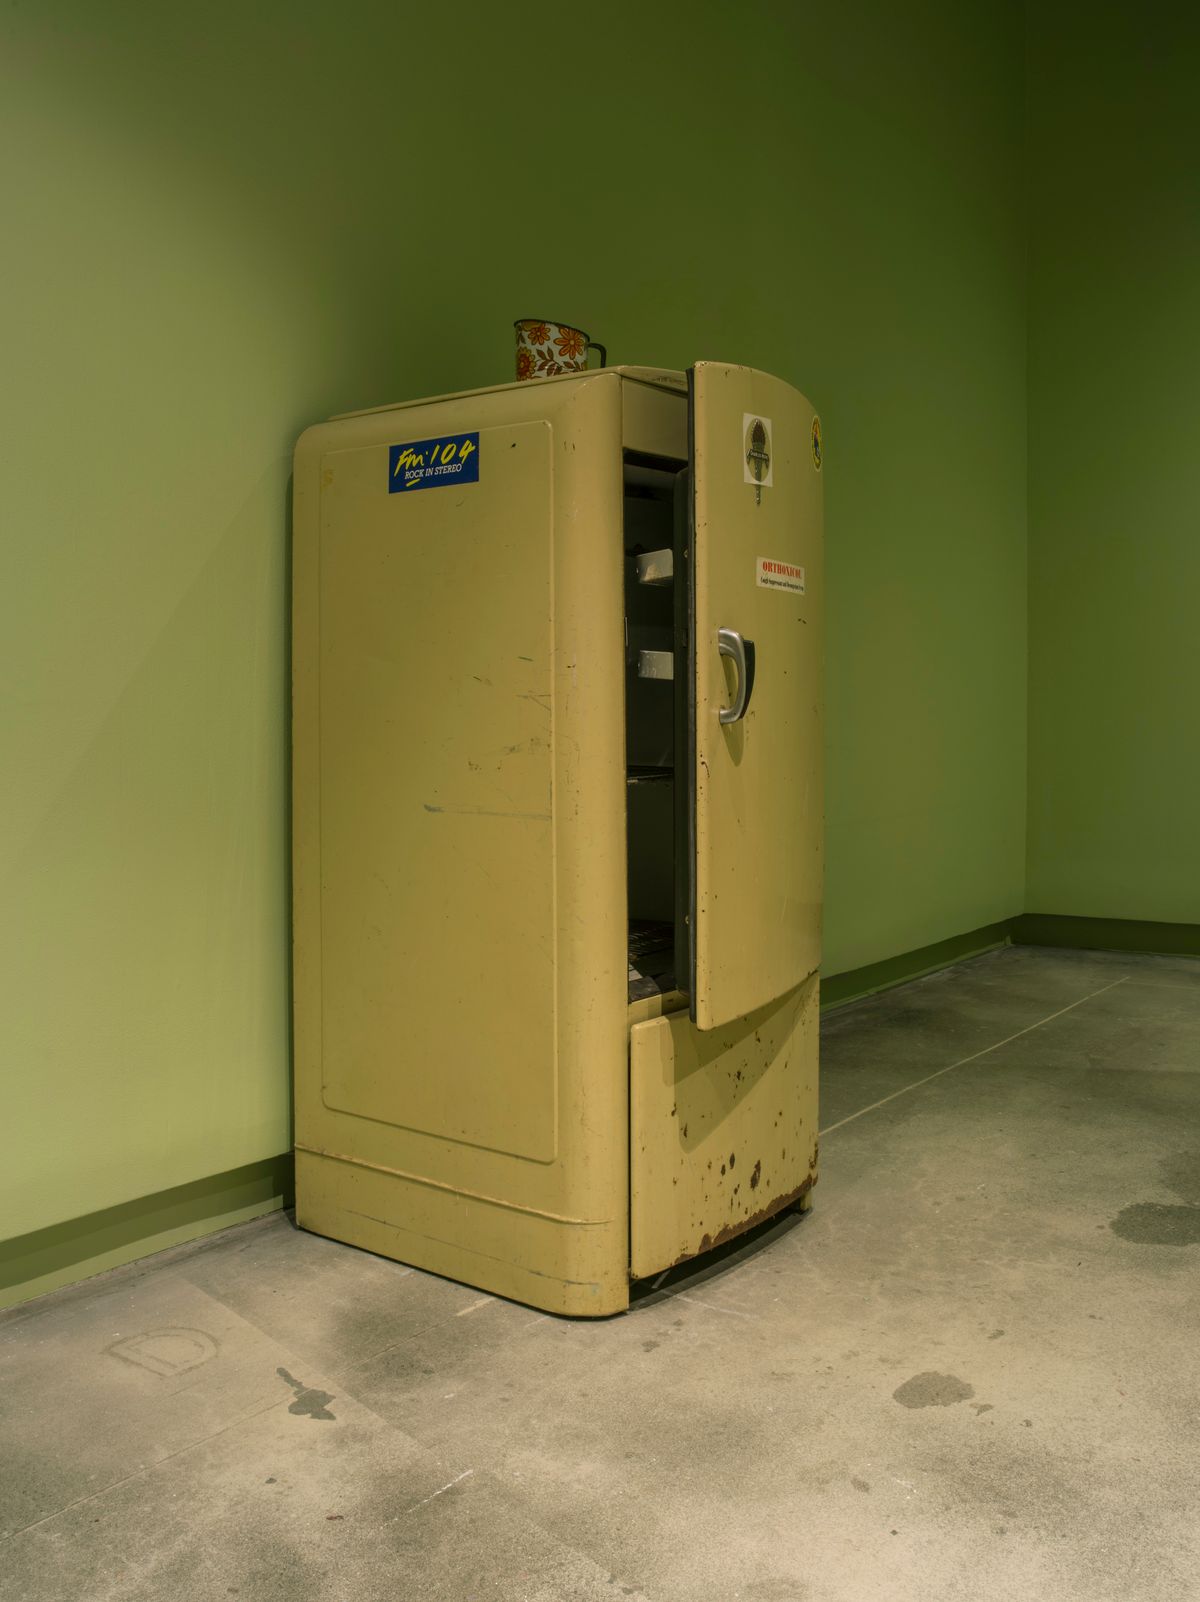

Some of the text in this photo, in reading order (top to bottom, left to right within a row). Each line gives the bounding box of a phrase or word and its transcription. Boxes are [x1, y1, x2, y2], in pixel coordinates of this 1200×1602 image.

[430, 440, 476, 465] 104
[404, 463, 463, 480] ROCK IN STEREO
